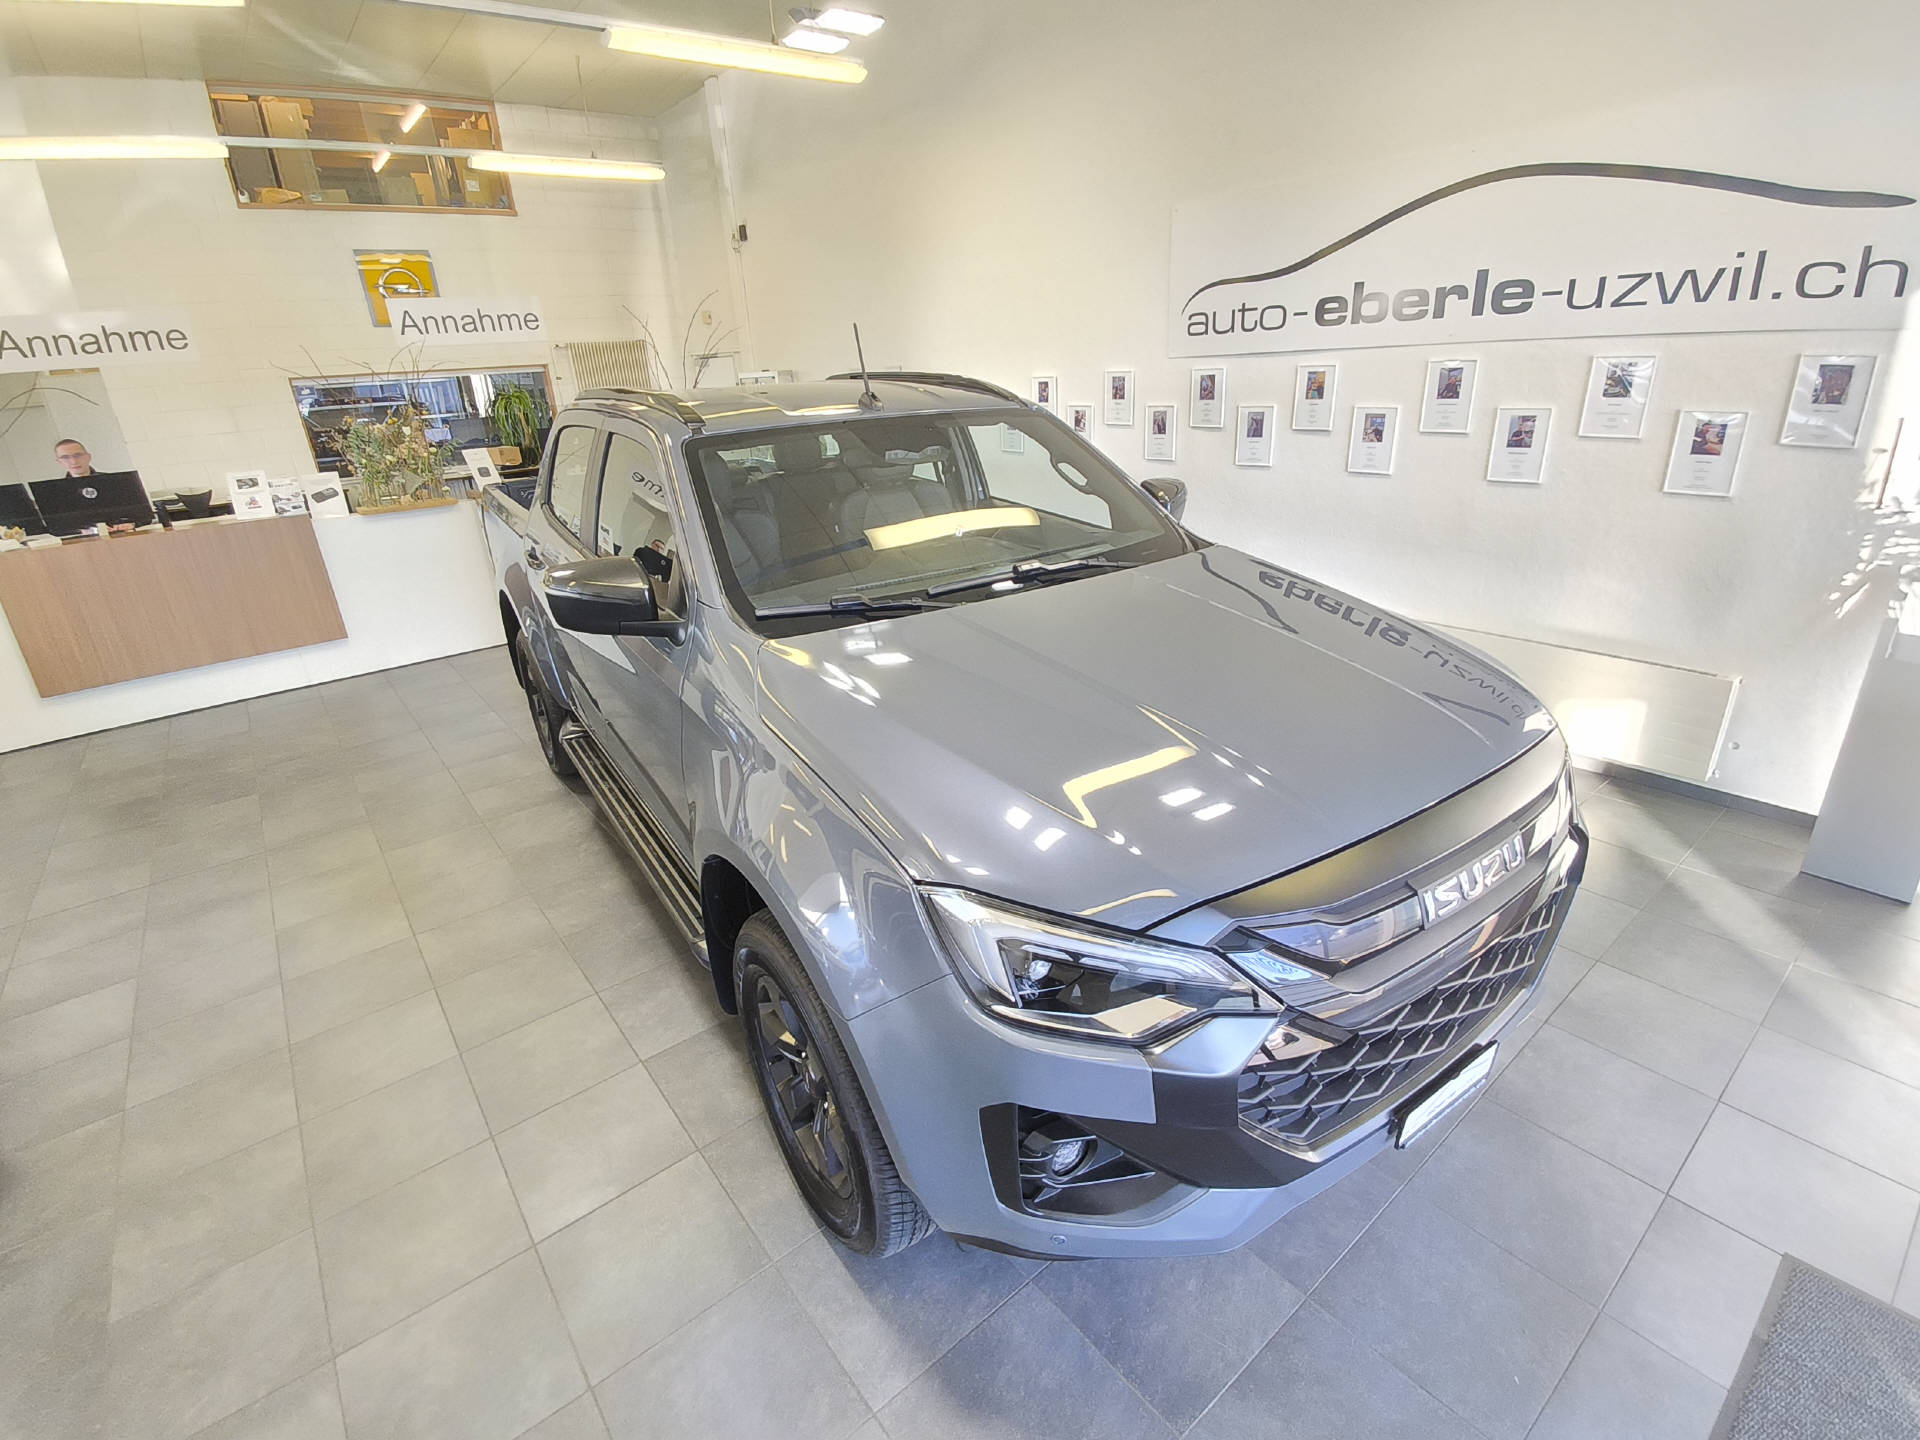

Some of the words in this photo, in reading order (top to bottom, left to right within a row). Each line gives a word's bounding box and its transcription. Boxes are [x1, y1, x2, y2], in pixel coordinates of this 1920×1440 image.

[400, 307, 540, 336] Annahme
[1186, 244, 1909, 337] auto-eberle-uzwil.ch
[0, 324, 189, 360] Annahme
[1423, 834, 1523, 923] ISUZU
